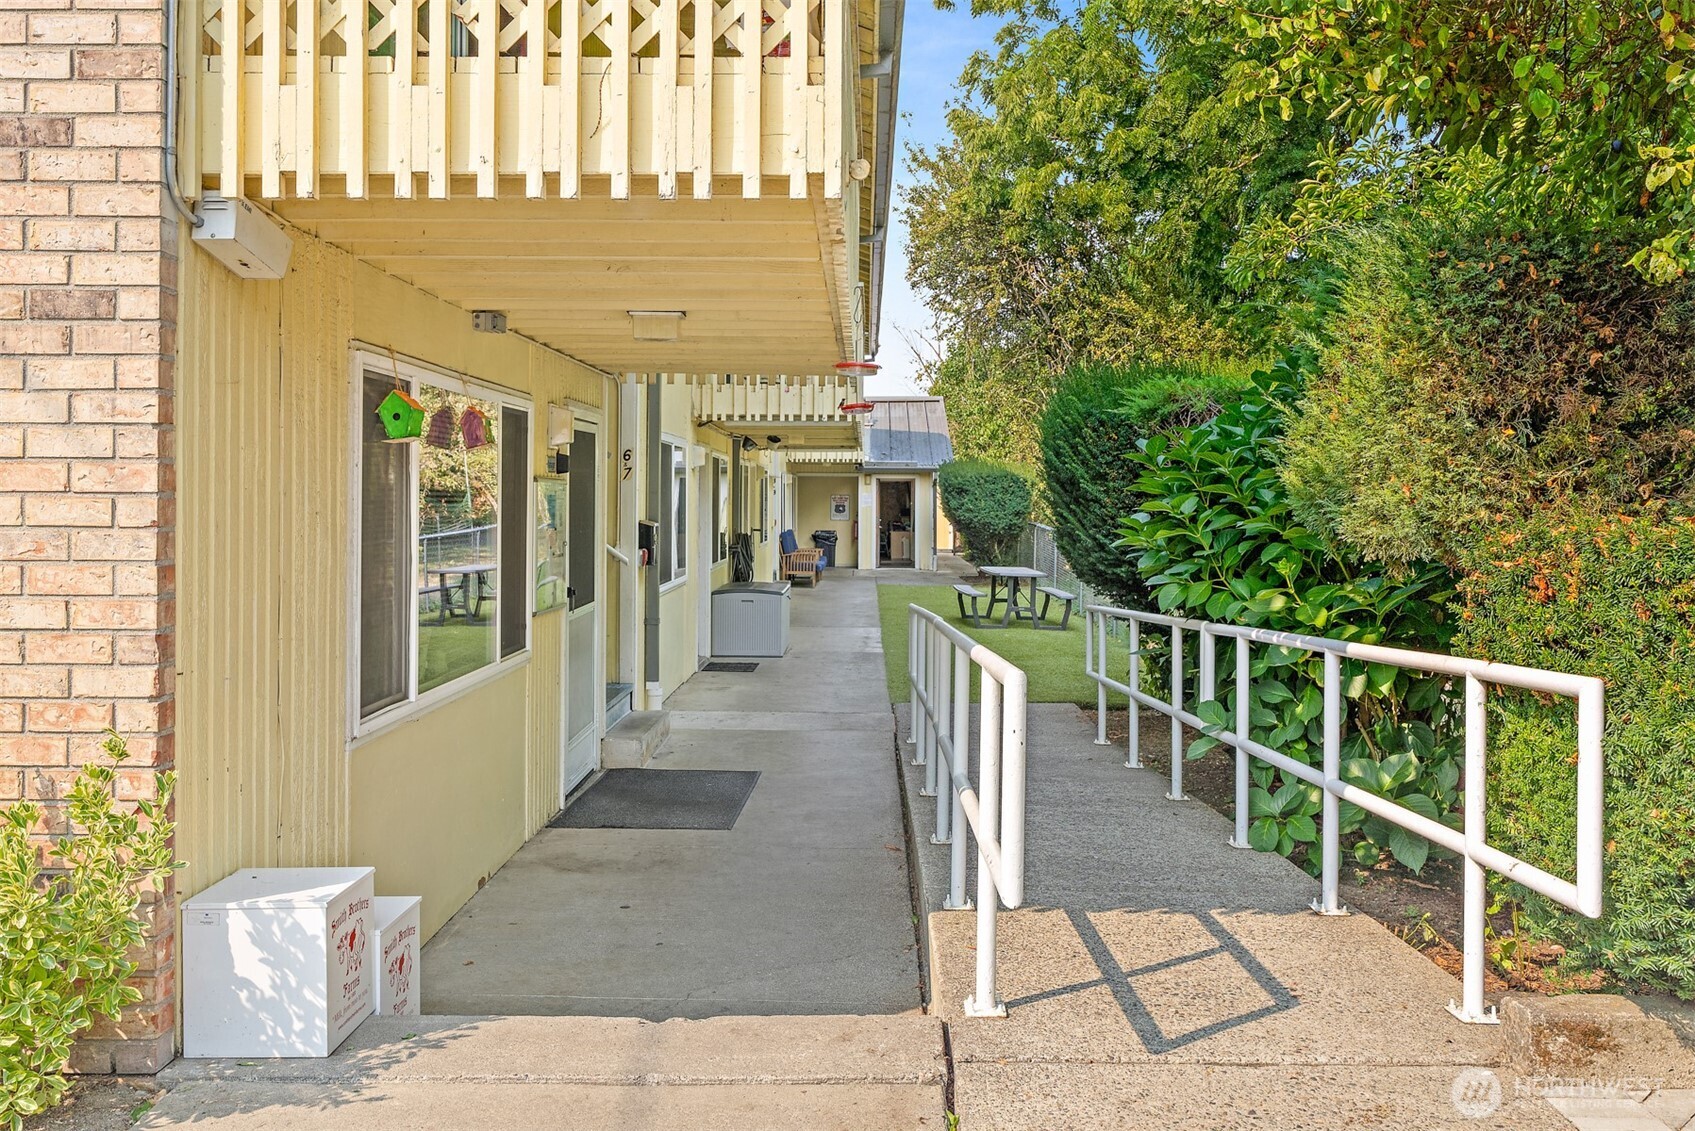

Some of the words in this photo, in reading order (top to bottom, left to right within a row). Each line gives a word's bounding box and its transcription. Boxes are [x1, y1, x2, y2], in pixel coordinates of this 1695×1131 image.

[623, 449, 632, 461] 6
[623, 467, 632, 481] 7
[331, 908, 346, 939] Smith
[348, 897, 369, 920] Brothers
[343, 976, 360, 998] Farms
